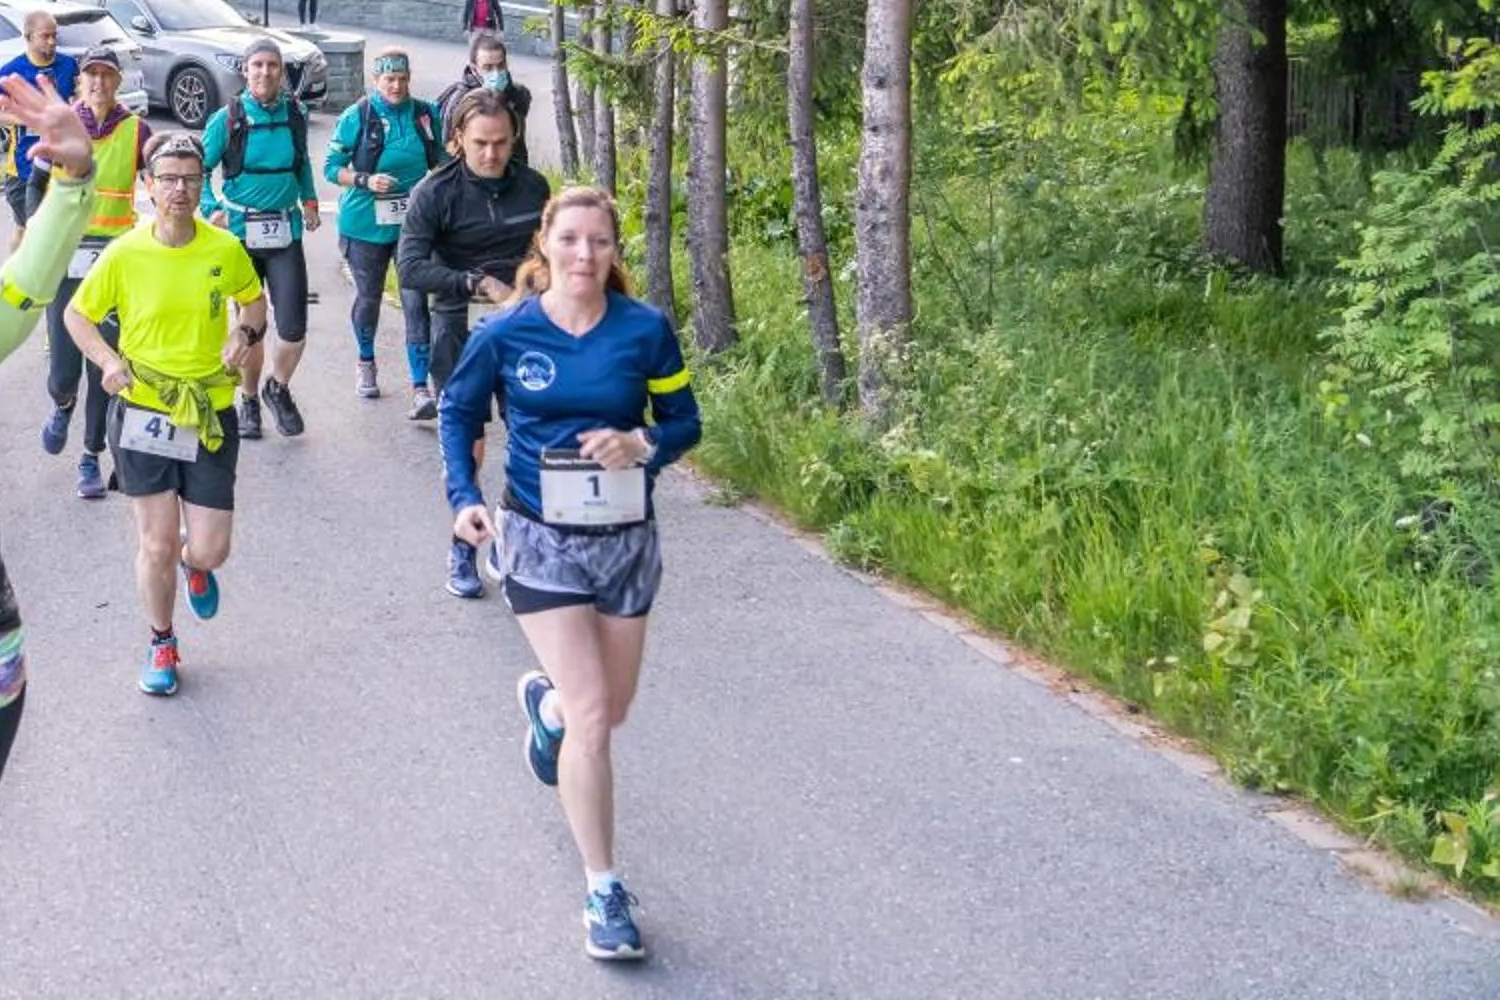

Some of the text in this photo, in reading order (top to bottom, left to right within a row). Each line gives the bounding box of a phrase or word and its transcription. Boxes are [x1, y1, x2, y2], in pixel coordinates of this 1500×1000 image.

[390, 199, 408, 213] 35
[261, 222, 279, 235] 37
[145, 416, 176, 441] 41
[587, 474, 600, 497] 1
